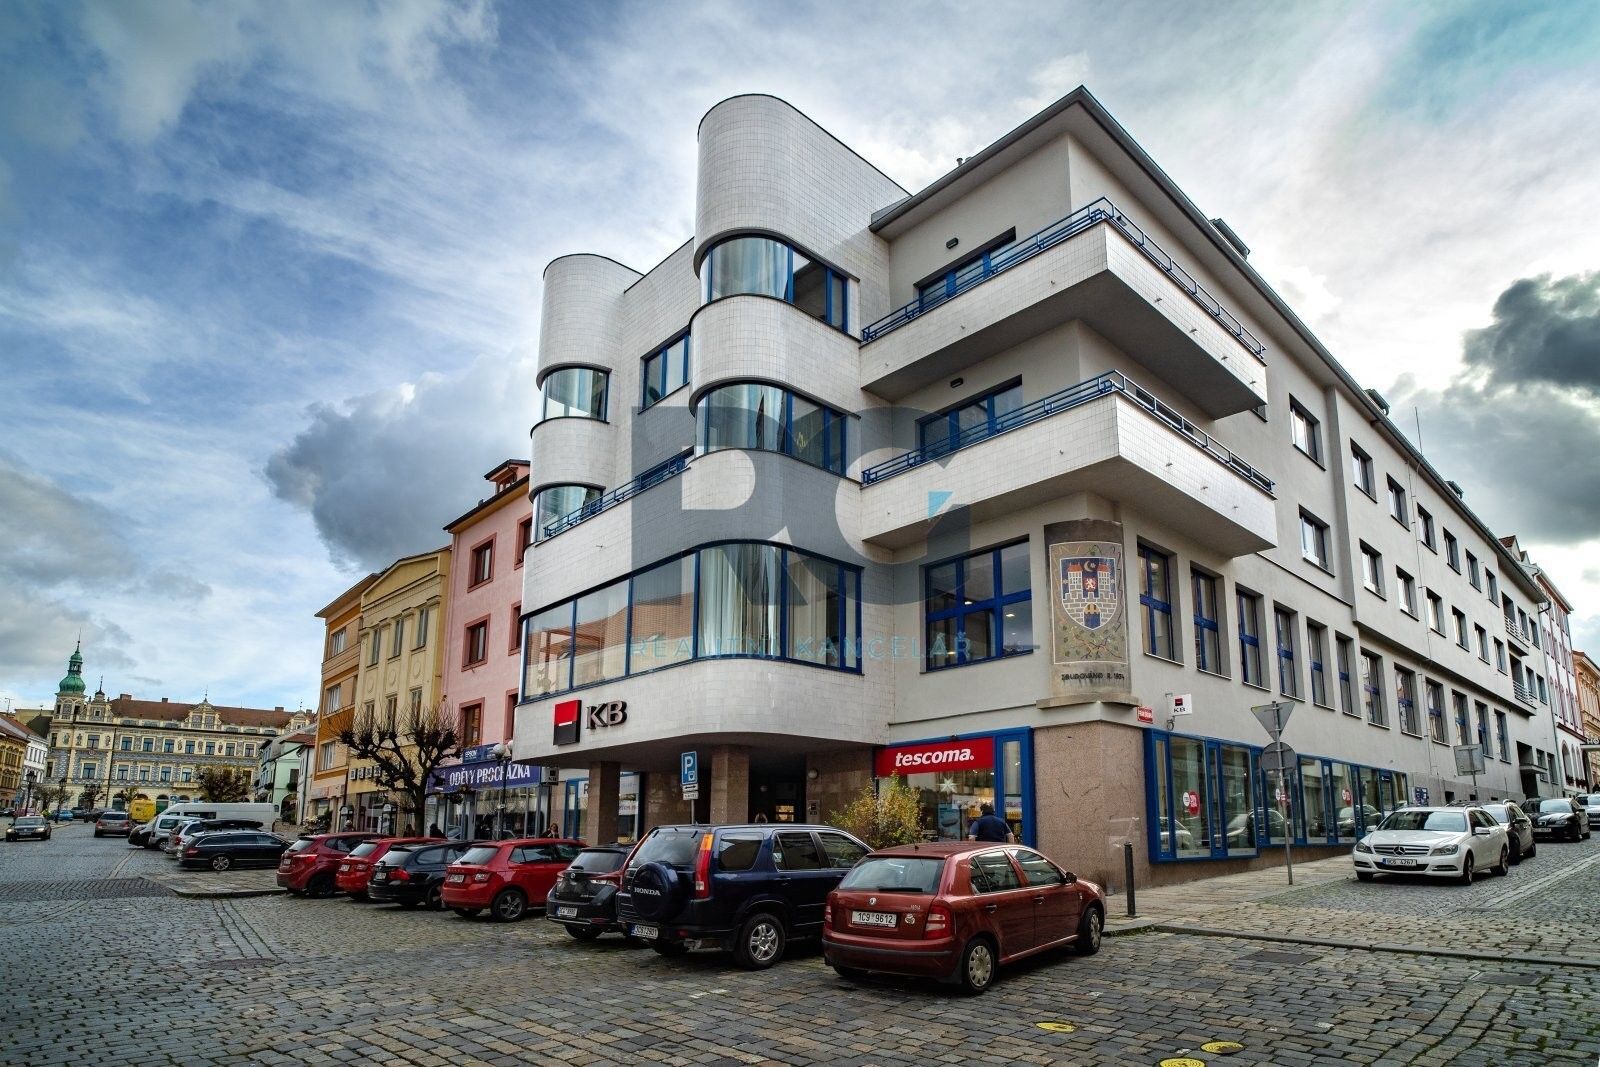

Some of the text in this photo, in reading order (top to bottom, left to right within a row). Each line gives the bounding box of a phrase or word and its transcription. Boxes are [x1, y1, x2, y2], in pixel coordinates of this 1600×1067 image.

[586, 700, 628, 730] KB
[684, 755, 694, 775] P
[634, 886, 661, 897] HONDA
[857, 912, 893, 924] 1C9 9612
